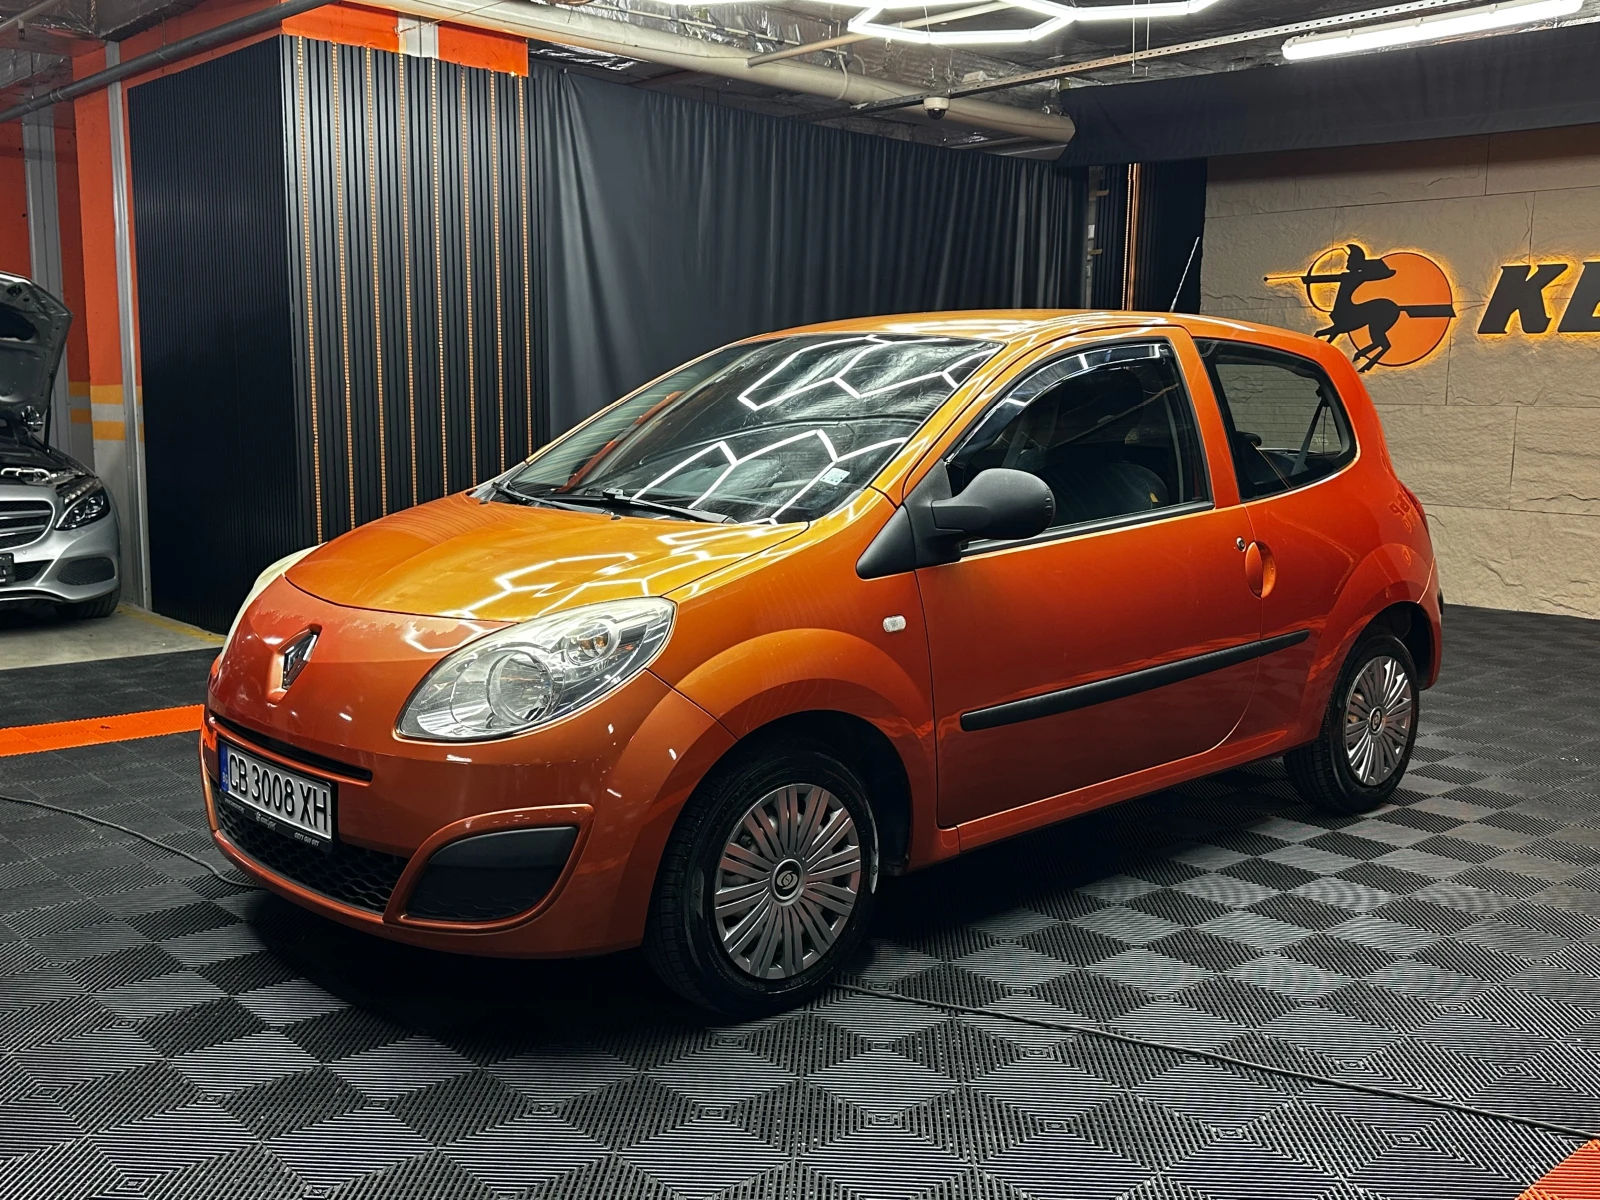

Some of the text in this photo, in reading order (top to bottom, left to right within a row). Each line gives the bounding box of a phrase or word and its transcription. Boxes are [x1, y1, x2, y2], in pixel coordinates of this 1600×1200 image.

[229, 753, 328, 832] CB 3008 XH
